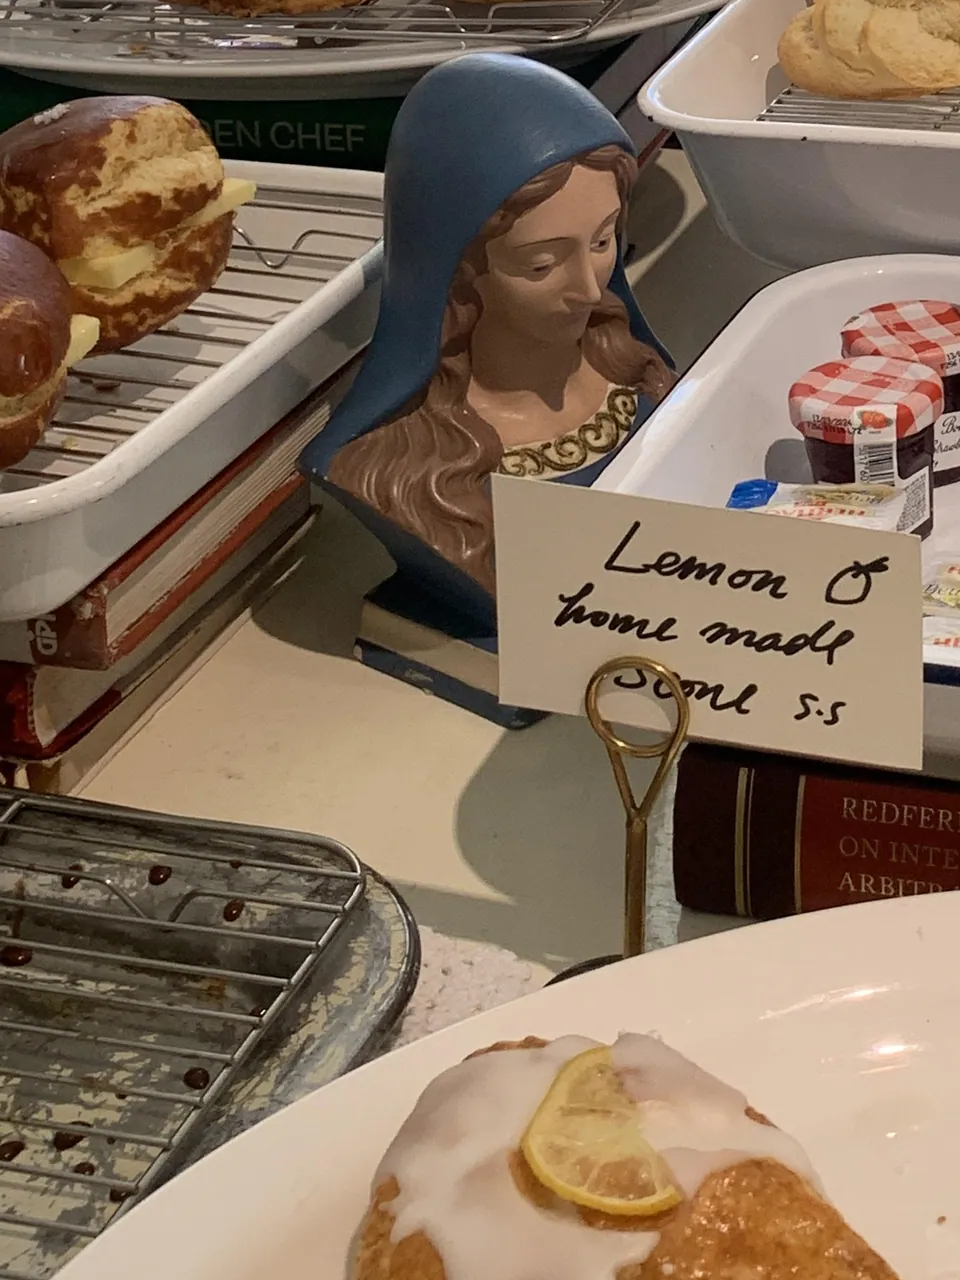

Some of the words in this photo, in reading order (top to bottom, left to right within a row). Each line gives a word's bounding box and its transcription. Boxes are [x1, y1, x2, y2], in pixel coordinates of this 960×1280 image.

[269, 120, 366, 152] CHEF
[603, 520, 788, 600] Lemon
[553, 582, 679, 643] home
[699, 619, 856, 666] made
[838, 835, 881, 861] ON
